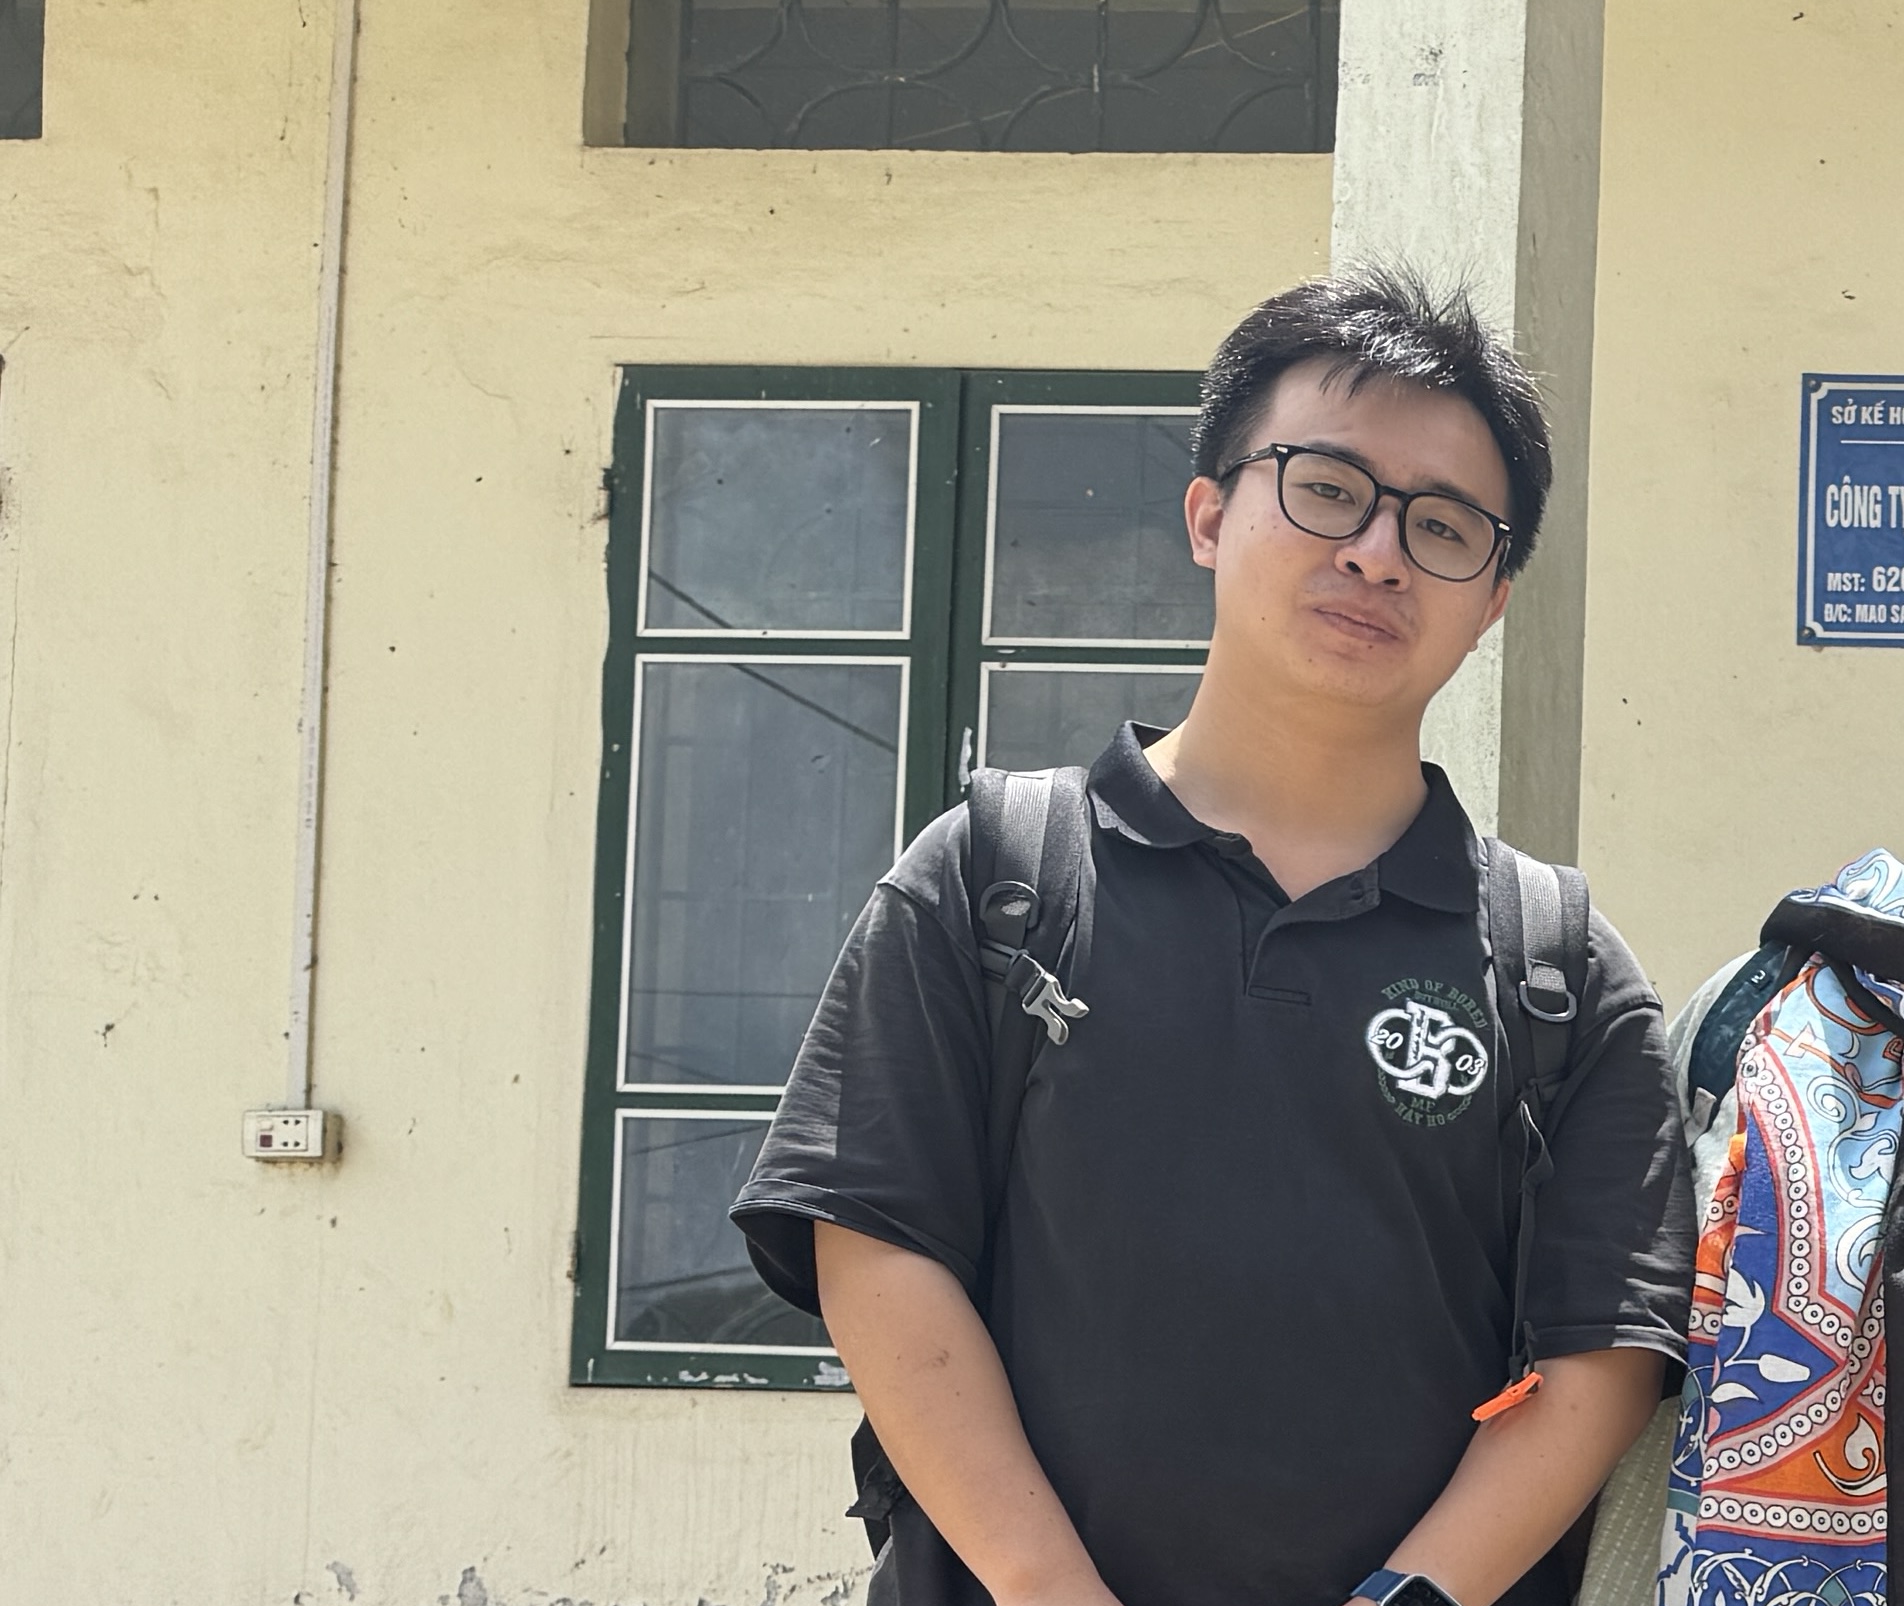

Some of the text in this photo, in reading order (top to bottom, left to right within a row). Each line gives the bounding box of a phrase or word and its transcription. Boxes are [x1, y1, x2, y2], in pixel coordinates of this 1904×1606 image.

[1831, 398, 1858, 425] SỞ
[1860, 399, 1887, 425] KẾ
[1825, 474, 1883, 529] CÔNG
[1826, 572, 1866, 592] MST:
[1823, 603, 1852, 624] Đ/C:
[1855, 604, 1887, 624] MAO
[1424, 979, 1444, 993] OF
[1446, 987, 1488, 1029] BORED
[1371, 1029, 1404, 1050] 20
[1455, 1054, 1487, 1075] 03
